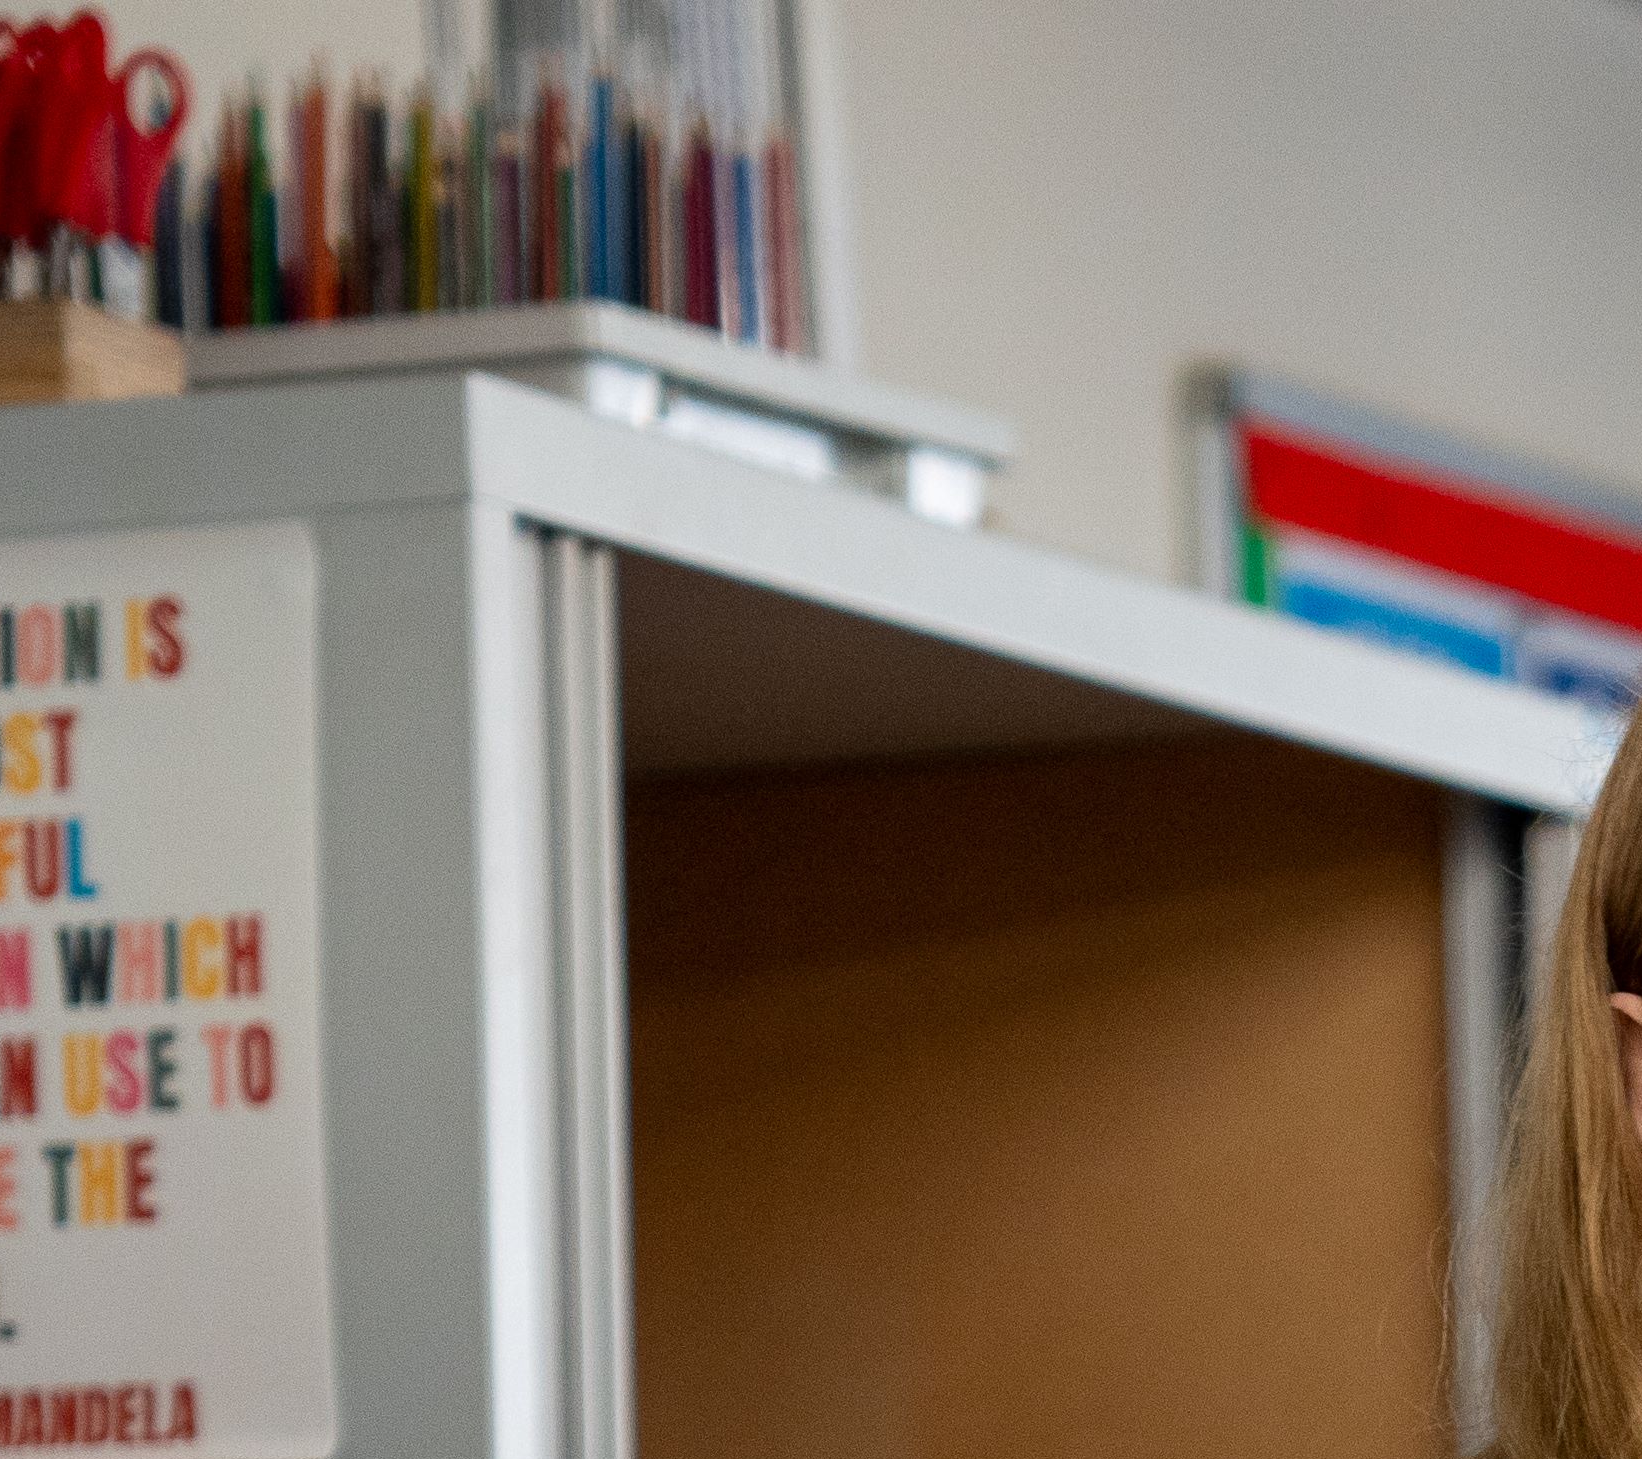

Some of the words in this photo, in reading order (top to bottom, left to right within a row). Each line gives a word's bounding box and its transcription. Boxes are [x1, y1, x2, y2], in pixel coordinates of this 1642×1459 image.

[128, 596, 186, 679] IS
[57, 919, 261, 1008] WHICH
[65, 1027, 181, 1116] USE
[208, 1022, 276, 1108] TO
[43, 1138, 158, 1227] THE
